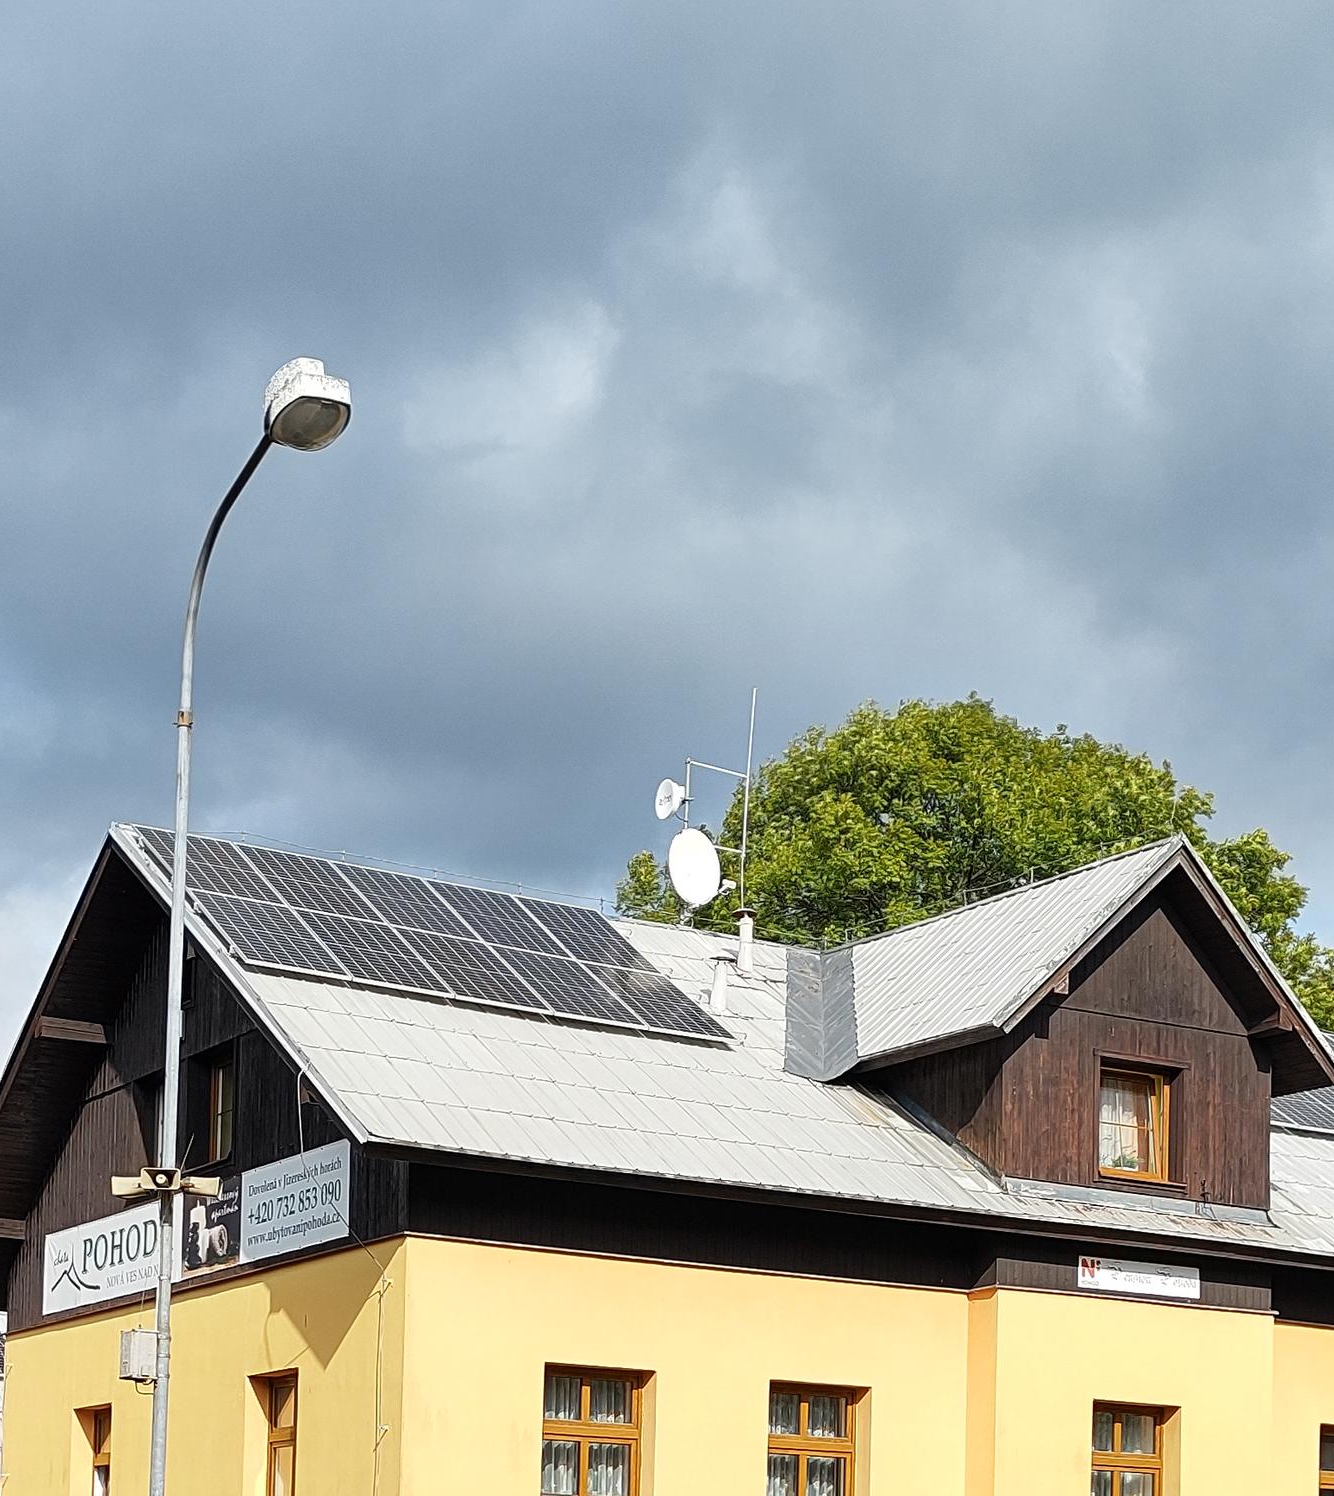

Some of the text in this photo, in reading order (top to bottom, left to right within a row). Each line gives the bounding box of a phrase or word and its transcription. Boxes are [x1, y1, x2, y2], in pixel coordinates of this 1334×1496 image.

[248, 1178, 277, 1197] Dovolená
[283, 1164, 318, 1190] Jizerských
[319, 1156, 342, 1175] horách
[247, 1179, 341, 1225] +420 732 853 090
[81, 1219, 158, 1275] POHOD
[107, 1271, 124, 1288] NOVÁ
[126, 1270, 137, 1284] VES
[139, 1266, 152, 1281] NAD
